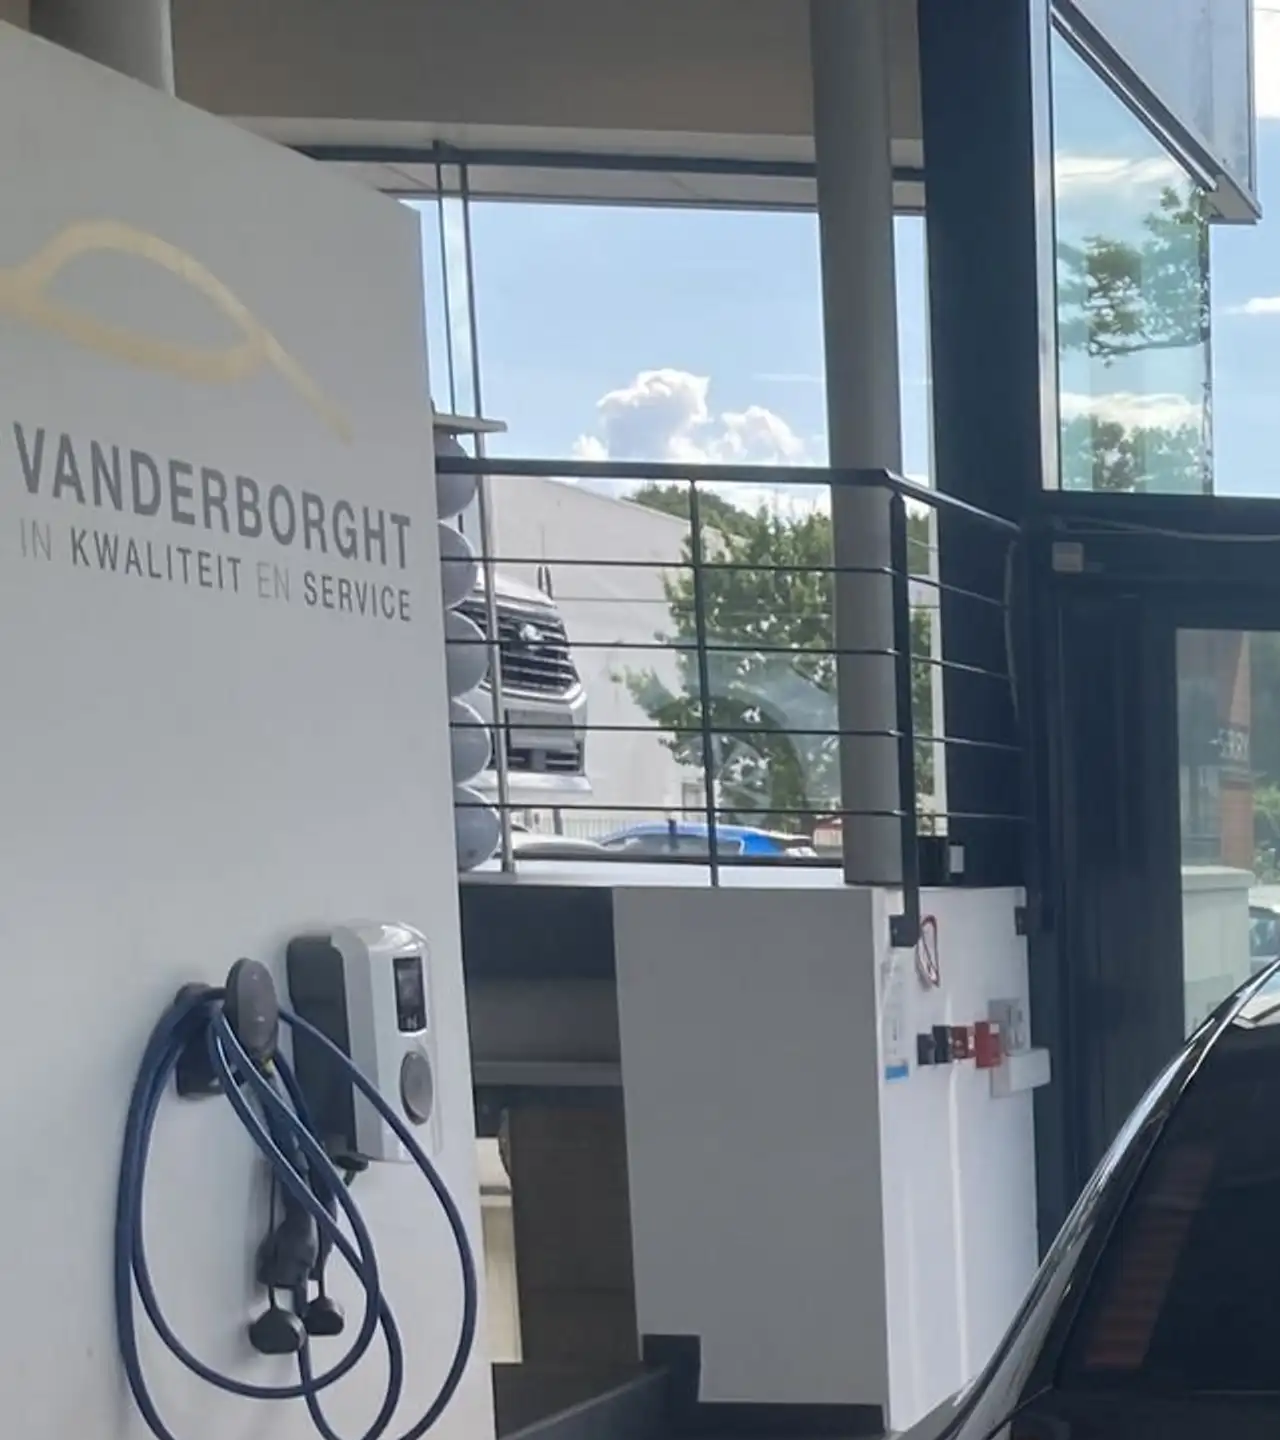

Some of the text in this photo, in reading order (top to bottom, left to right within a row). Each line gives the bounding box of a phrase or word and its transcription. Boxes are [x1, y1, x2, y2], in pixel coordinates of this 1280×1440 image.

[13, 420, 411, 569] VANDERBORGHT
[20, 517, 411, 622] IN KWALITEIT EN SERVICE
